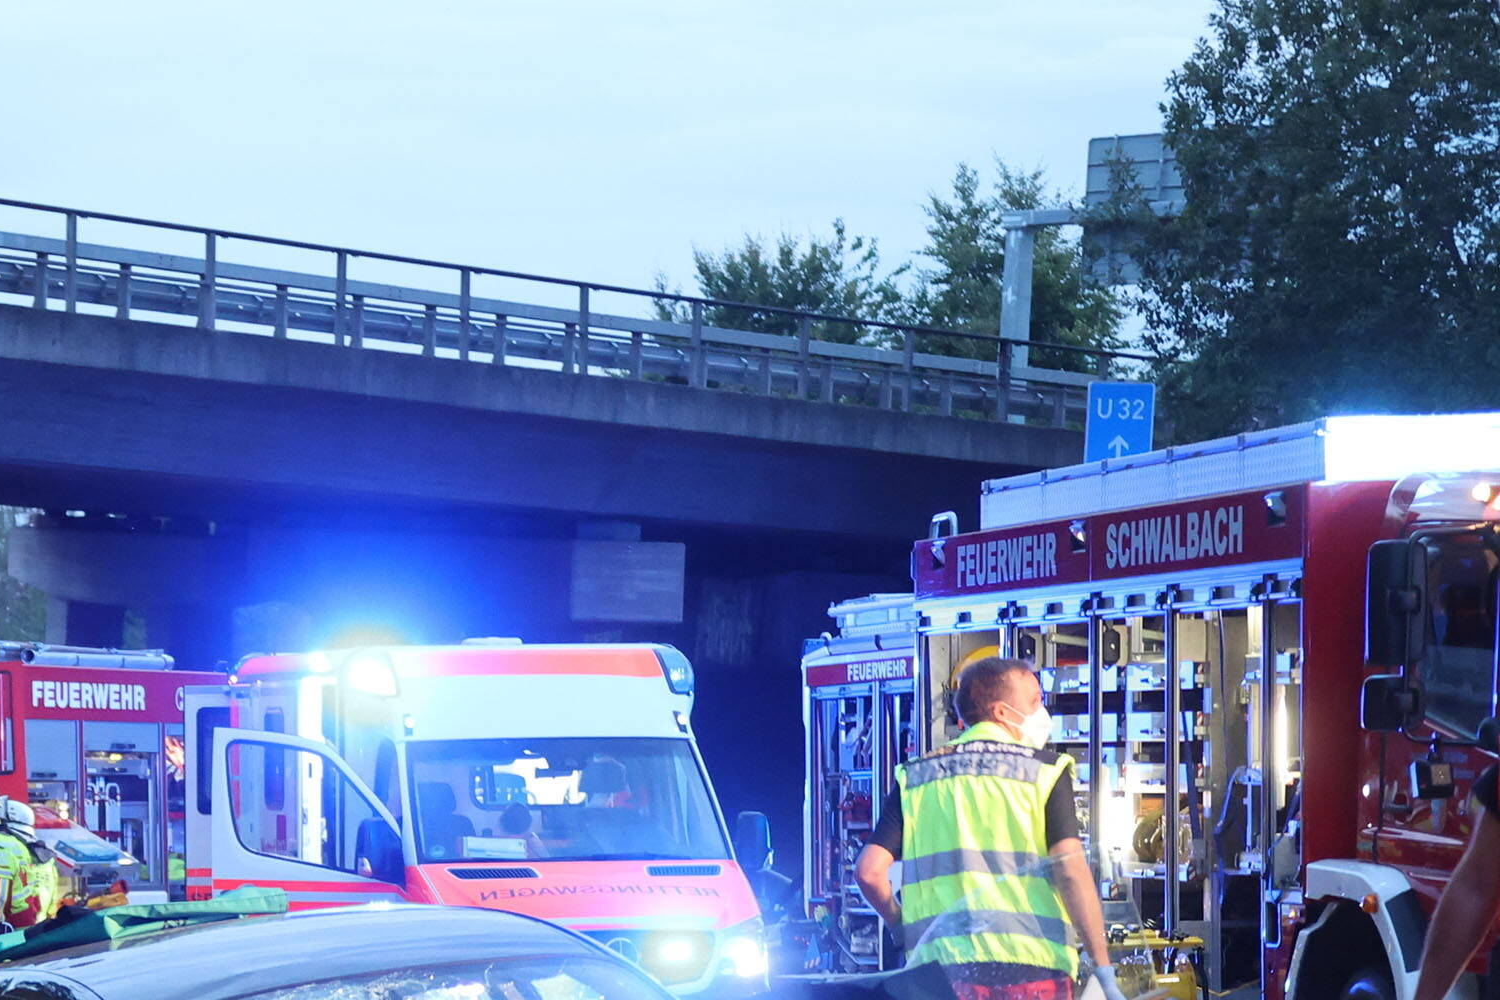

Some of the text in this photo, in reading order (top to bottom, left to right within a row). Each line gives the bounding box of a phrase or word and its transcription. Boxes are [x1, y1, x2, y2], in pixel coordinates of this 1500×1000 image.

[1097, 397, 1145, 420] U 32
[956, 504, 1244, 588] FEUERWEHR SCHWALBACH
[846, 658, 908, 682] FEUERWEHR
[31, 680, 146, 711] FEUERWEHR
